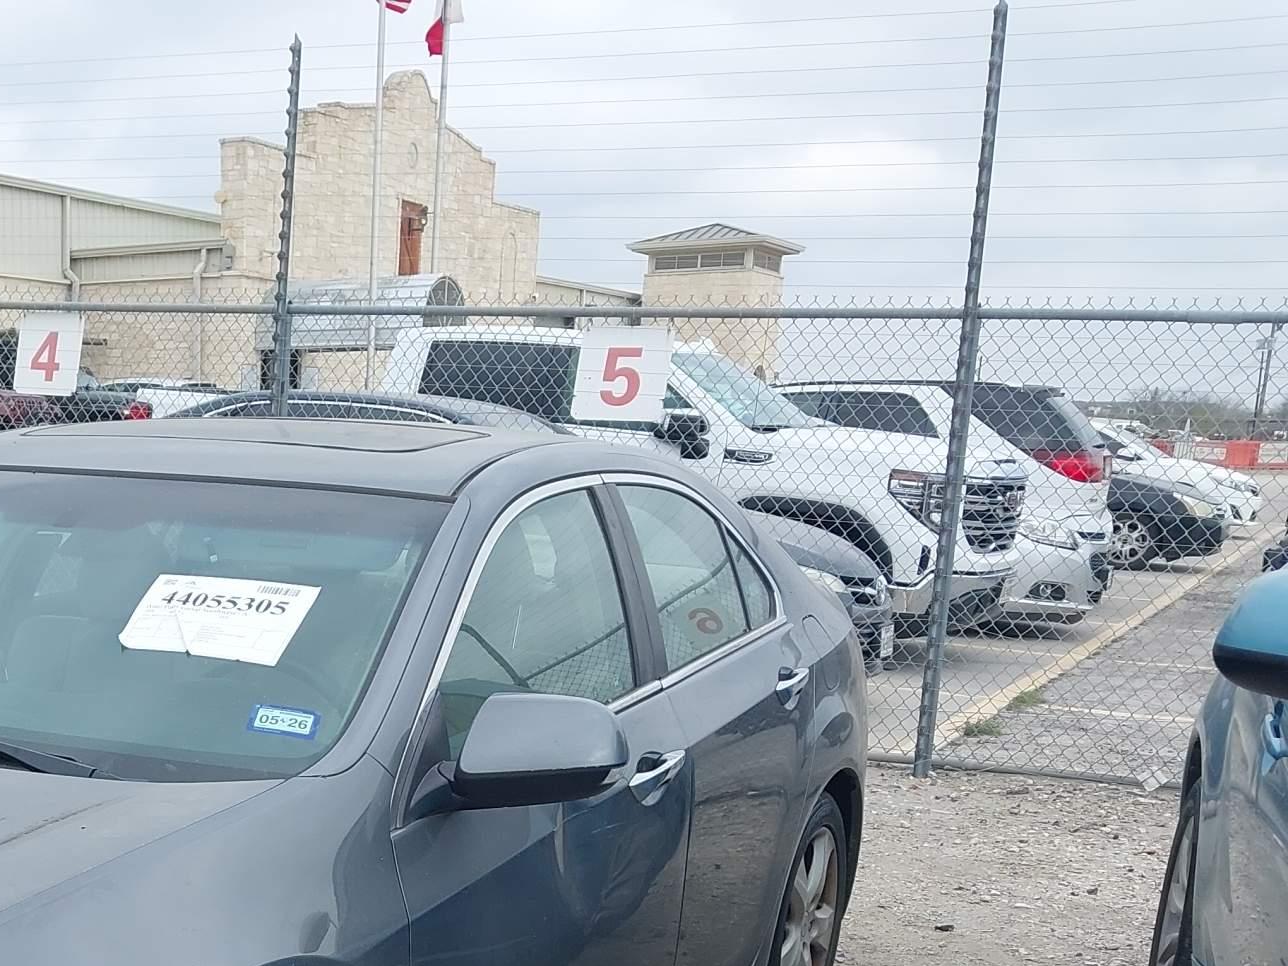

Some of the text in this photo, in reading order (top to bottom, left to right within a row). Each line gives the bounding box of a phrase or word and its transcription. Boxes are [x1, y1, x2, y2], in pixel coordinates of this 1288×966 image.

[30, 331, 59, 381] 4
[599, 347, 642, 406] 5
[161, 591, 290, 616] 44055305
